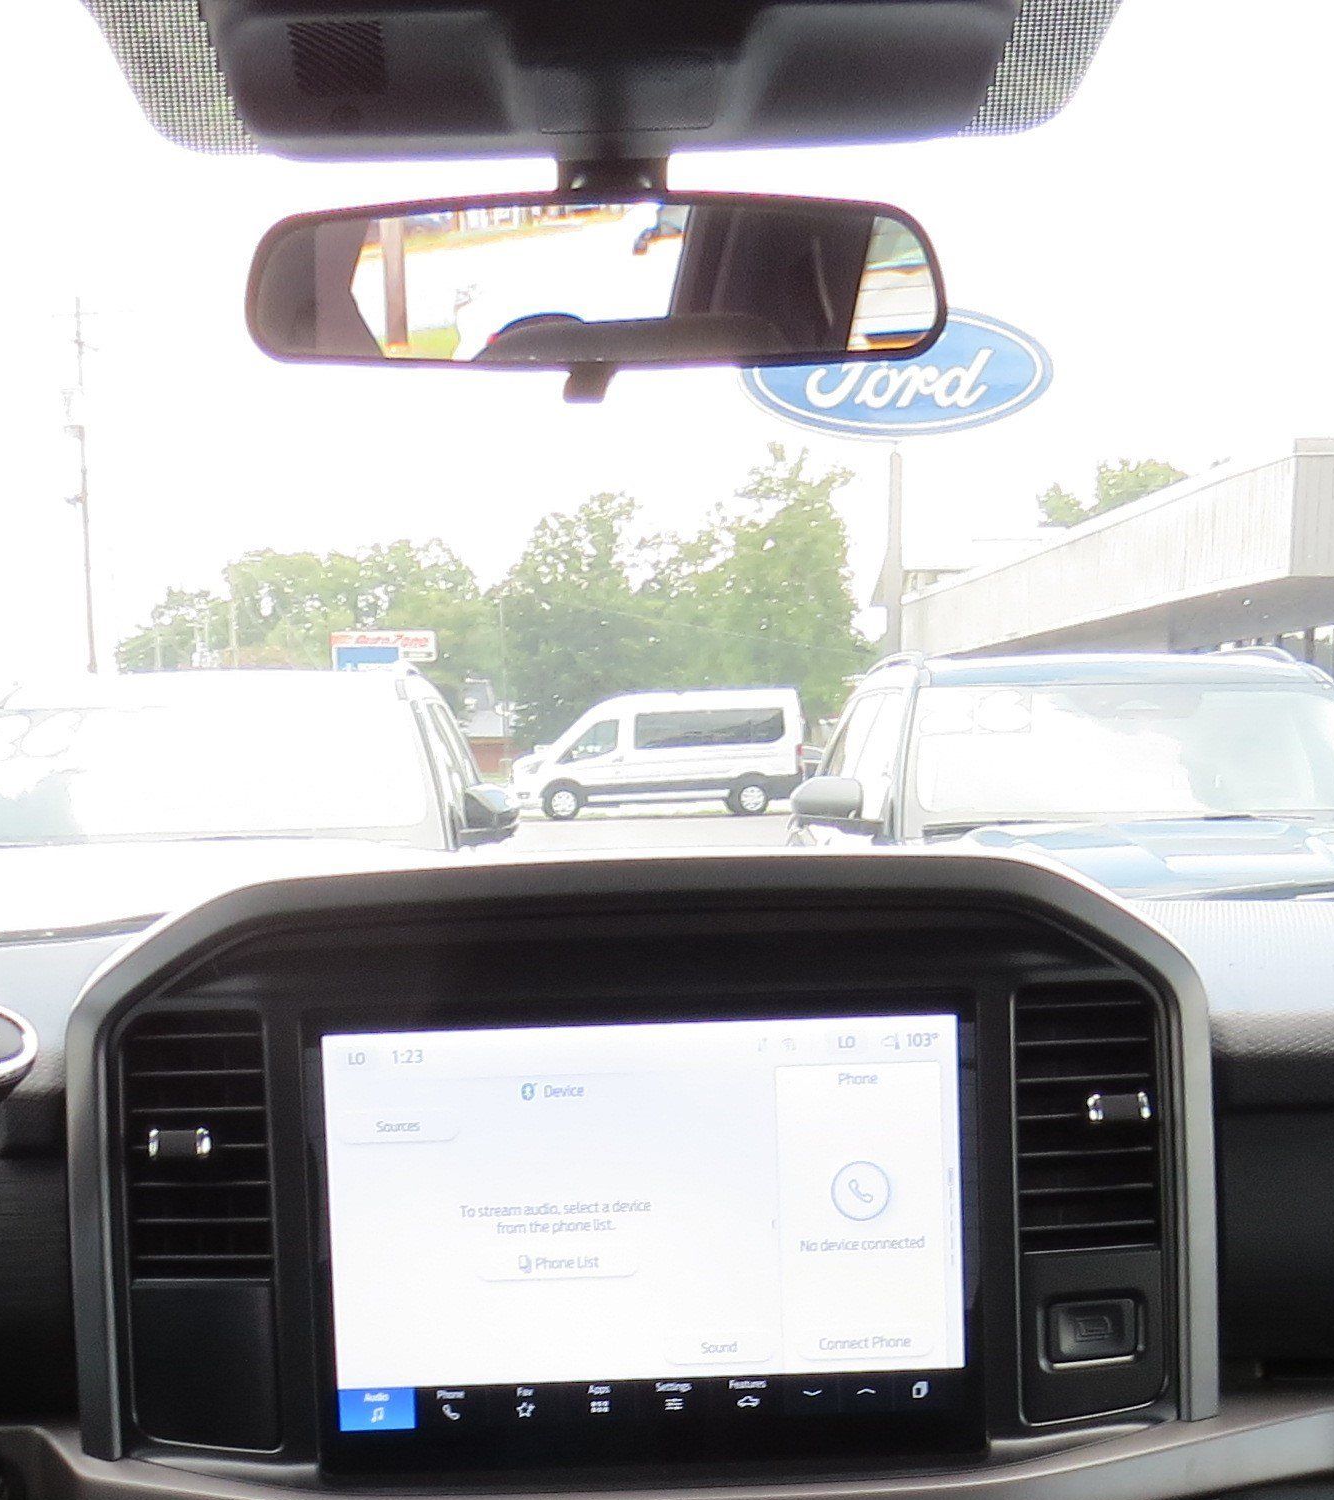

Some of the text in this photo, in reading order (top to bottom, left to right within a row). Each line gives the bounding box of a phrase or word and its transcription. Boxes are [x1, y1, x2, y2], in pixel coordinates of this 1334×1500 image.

[837, 1035, 856, 1049] LO
[347, 1051, 367, 1066] LO
[391, 1049, 425, 1065] 1:23
[837, 1072, 879, 1086] Phone
[543, 1082, 585, 1099] Device
[375, 1120, 421, 1133] Sources
[461, 1204, 475, 1218] To
[478, 1204, 521, 1217] stream
[564, 1200, 598, 1214] select
[601, 1202, 609, 1213] a
[612, 1199, 652, 1212] device
[496, 1221, 526, 1234] from
[529, 1220, 549, 1233] the
[552, 1219, 591, 1235] phone
[800, 1235, 925, 1252] No device connected
[535, 1255, 600, 1270] Phone List
[700, 1340, 737, 1355] Sound
[818, 1335, 911, 1350] Connect Phone
